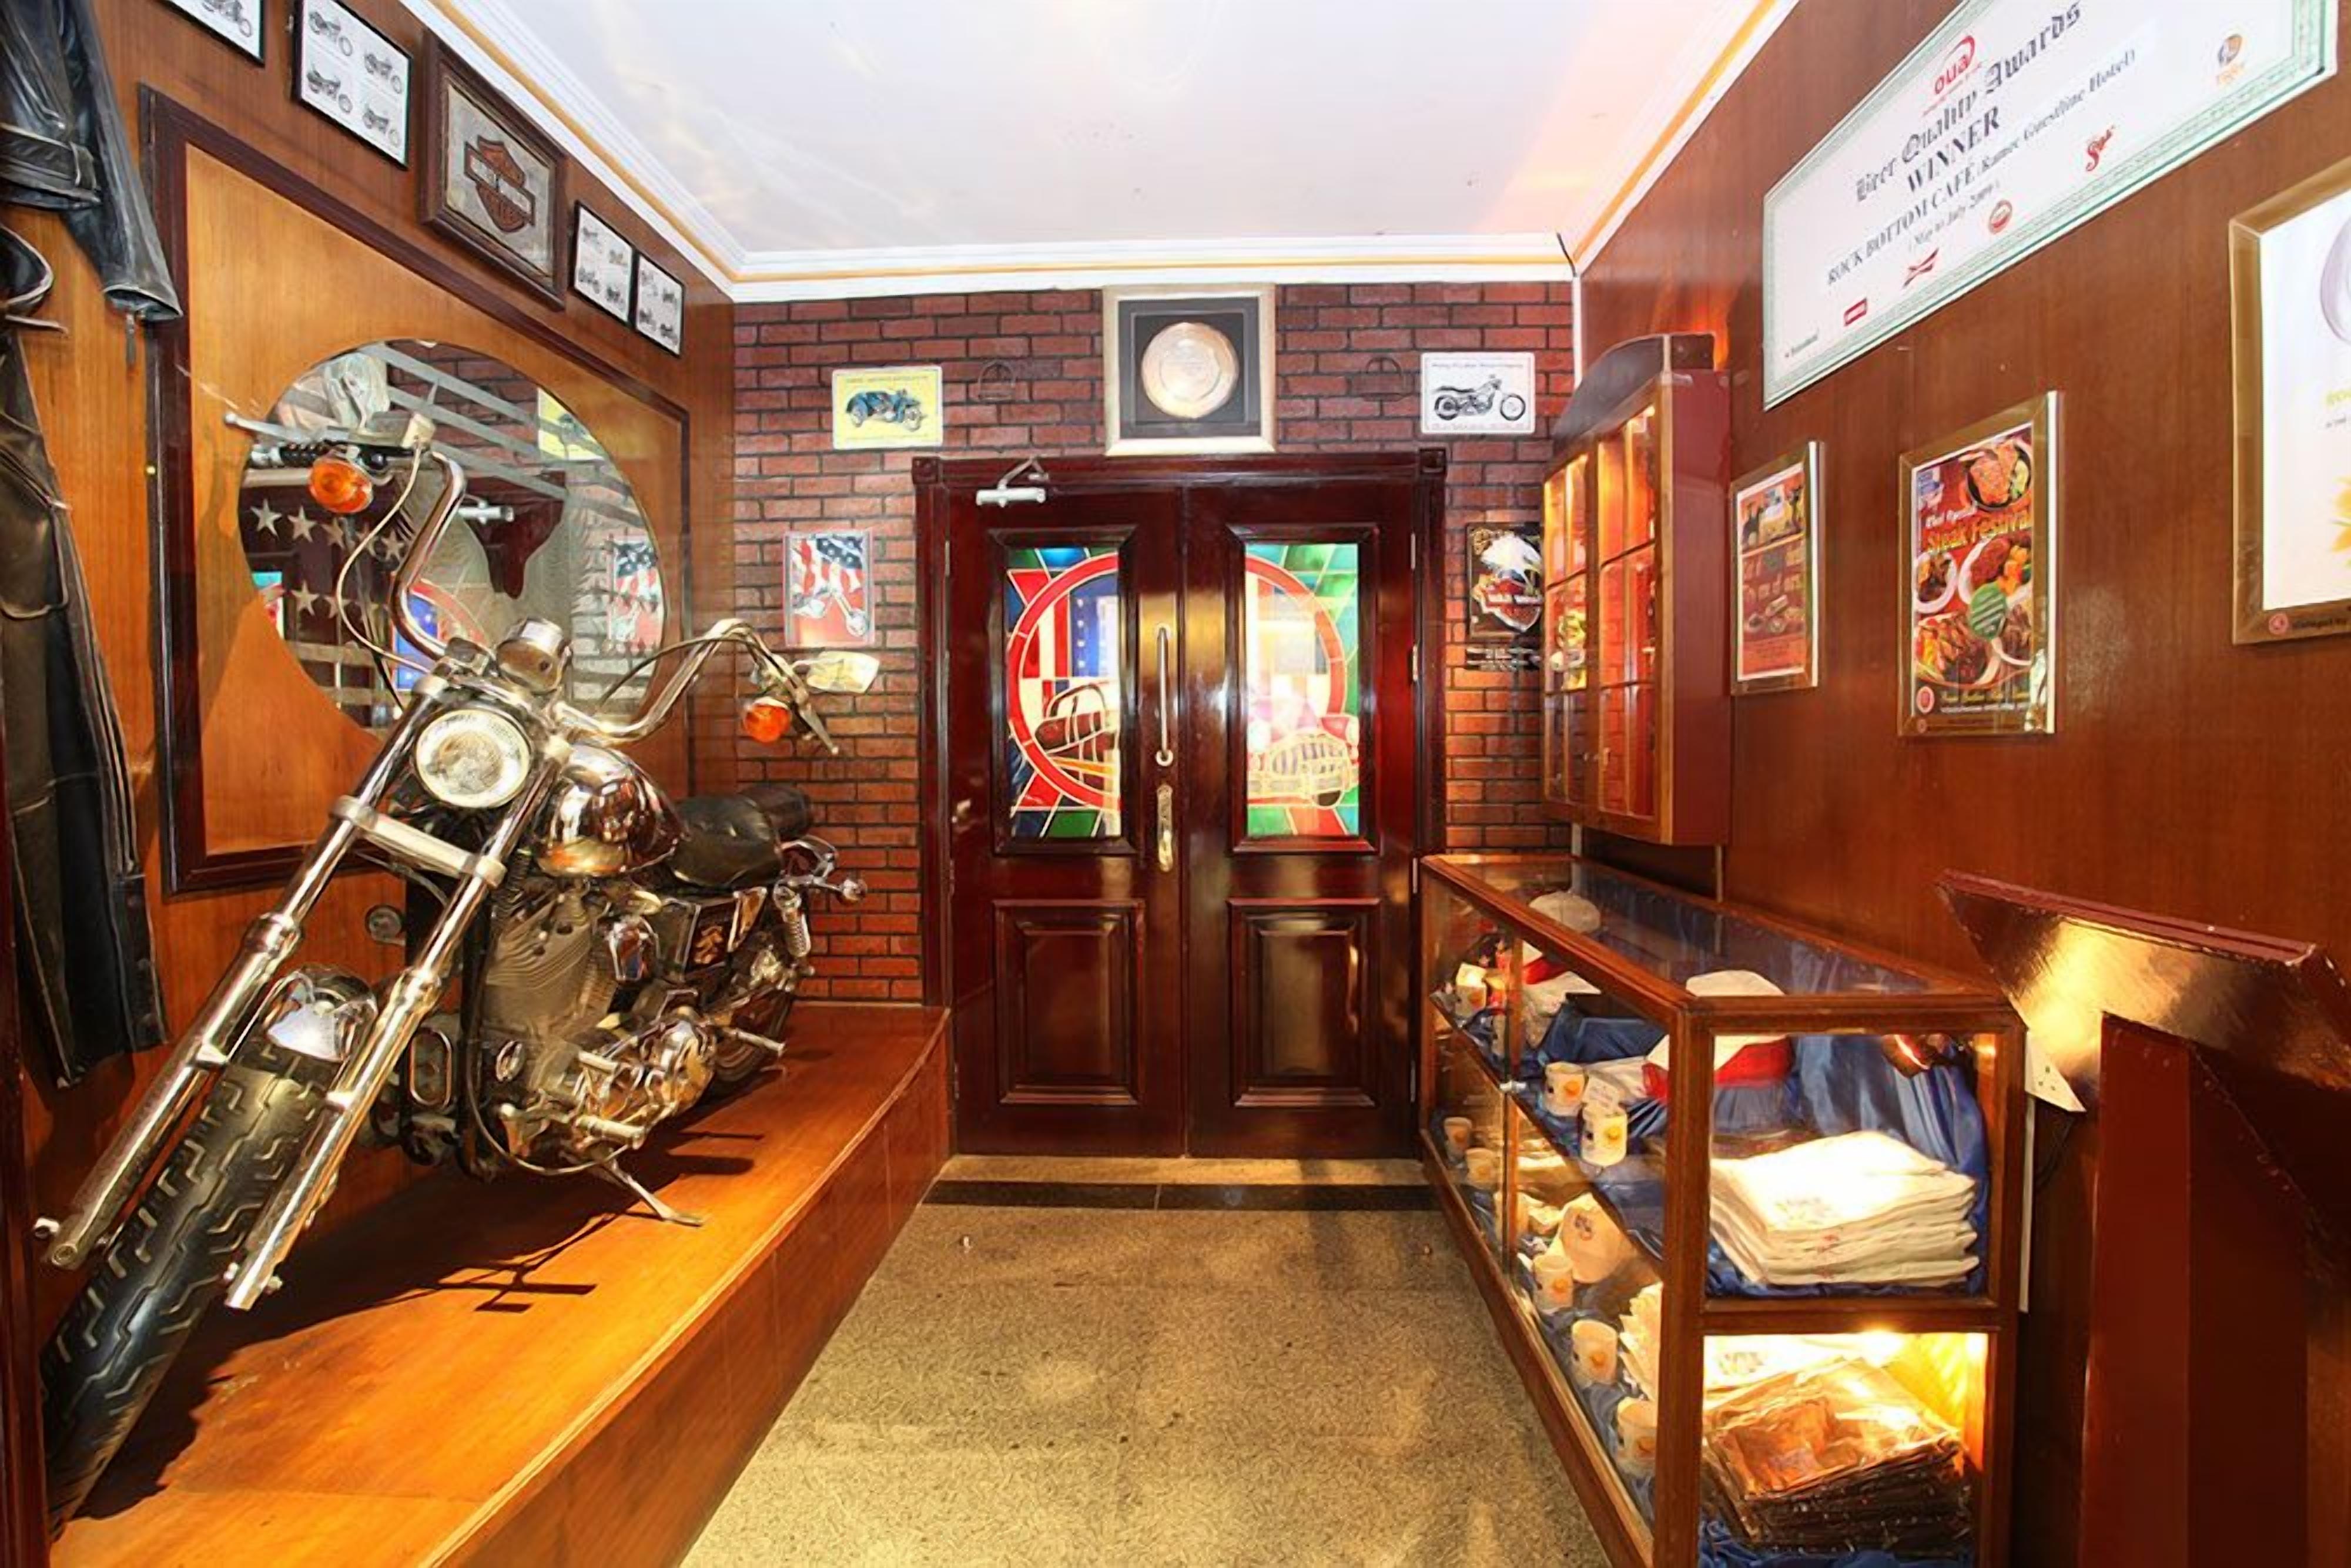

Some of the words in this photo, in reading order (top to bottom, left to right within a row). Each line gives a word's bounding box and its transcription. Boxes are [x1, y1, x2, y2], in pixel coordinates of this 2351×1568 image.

[1985, 1, 2080, 95] Awards
[1908, 106, 1999, 192] WINNER
[1866, 199, 1927, 257] BOTTOM
